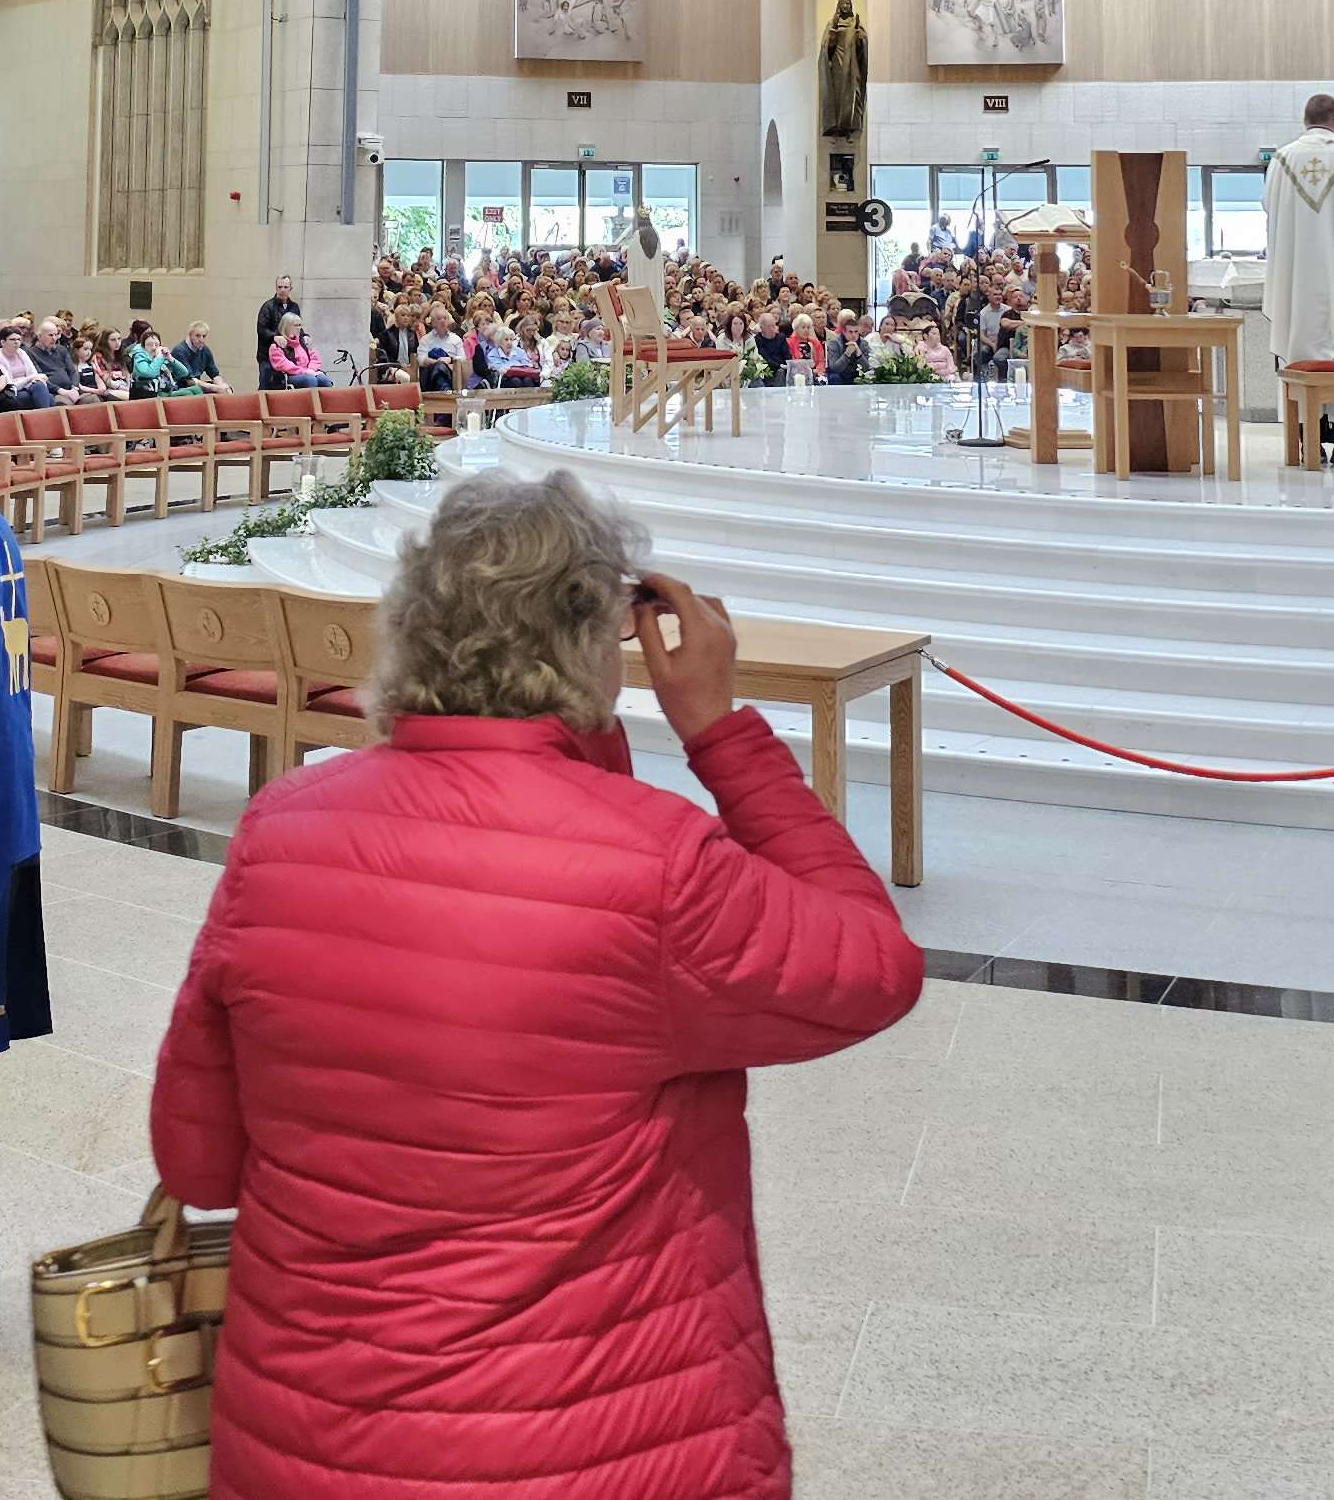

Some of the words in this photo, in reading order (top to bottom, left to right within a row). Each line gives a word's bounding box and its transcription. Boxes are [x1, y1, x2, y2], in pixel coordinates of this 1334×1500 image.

[571, 95, 588, 105] VII
[985, 98, 1007, 108] VIII
[864, 202, 886, 233] 3
